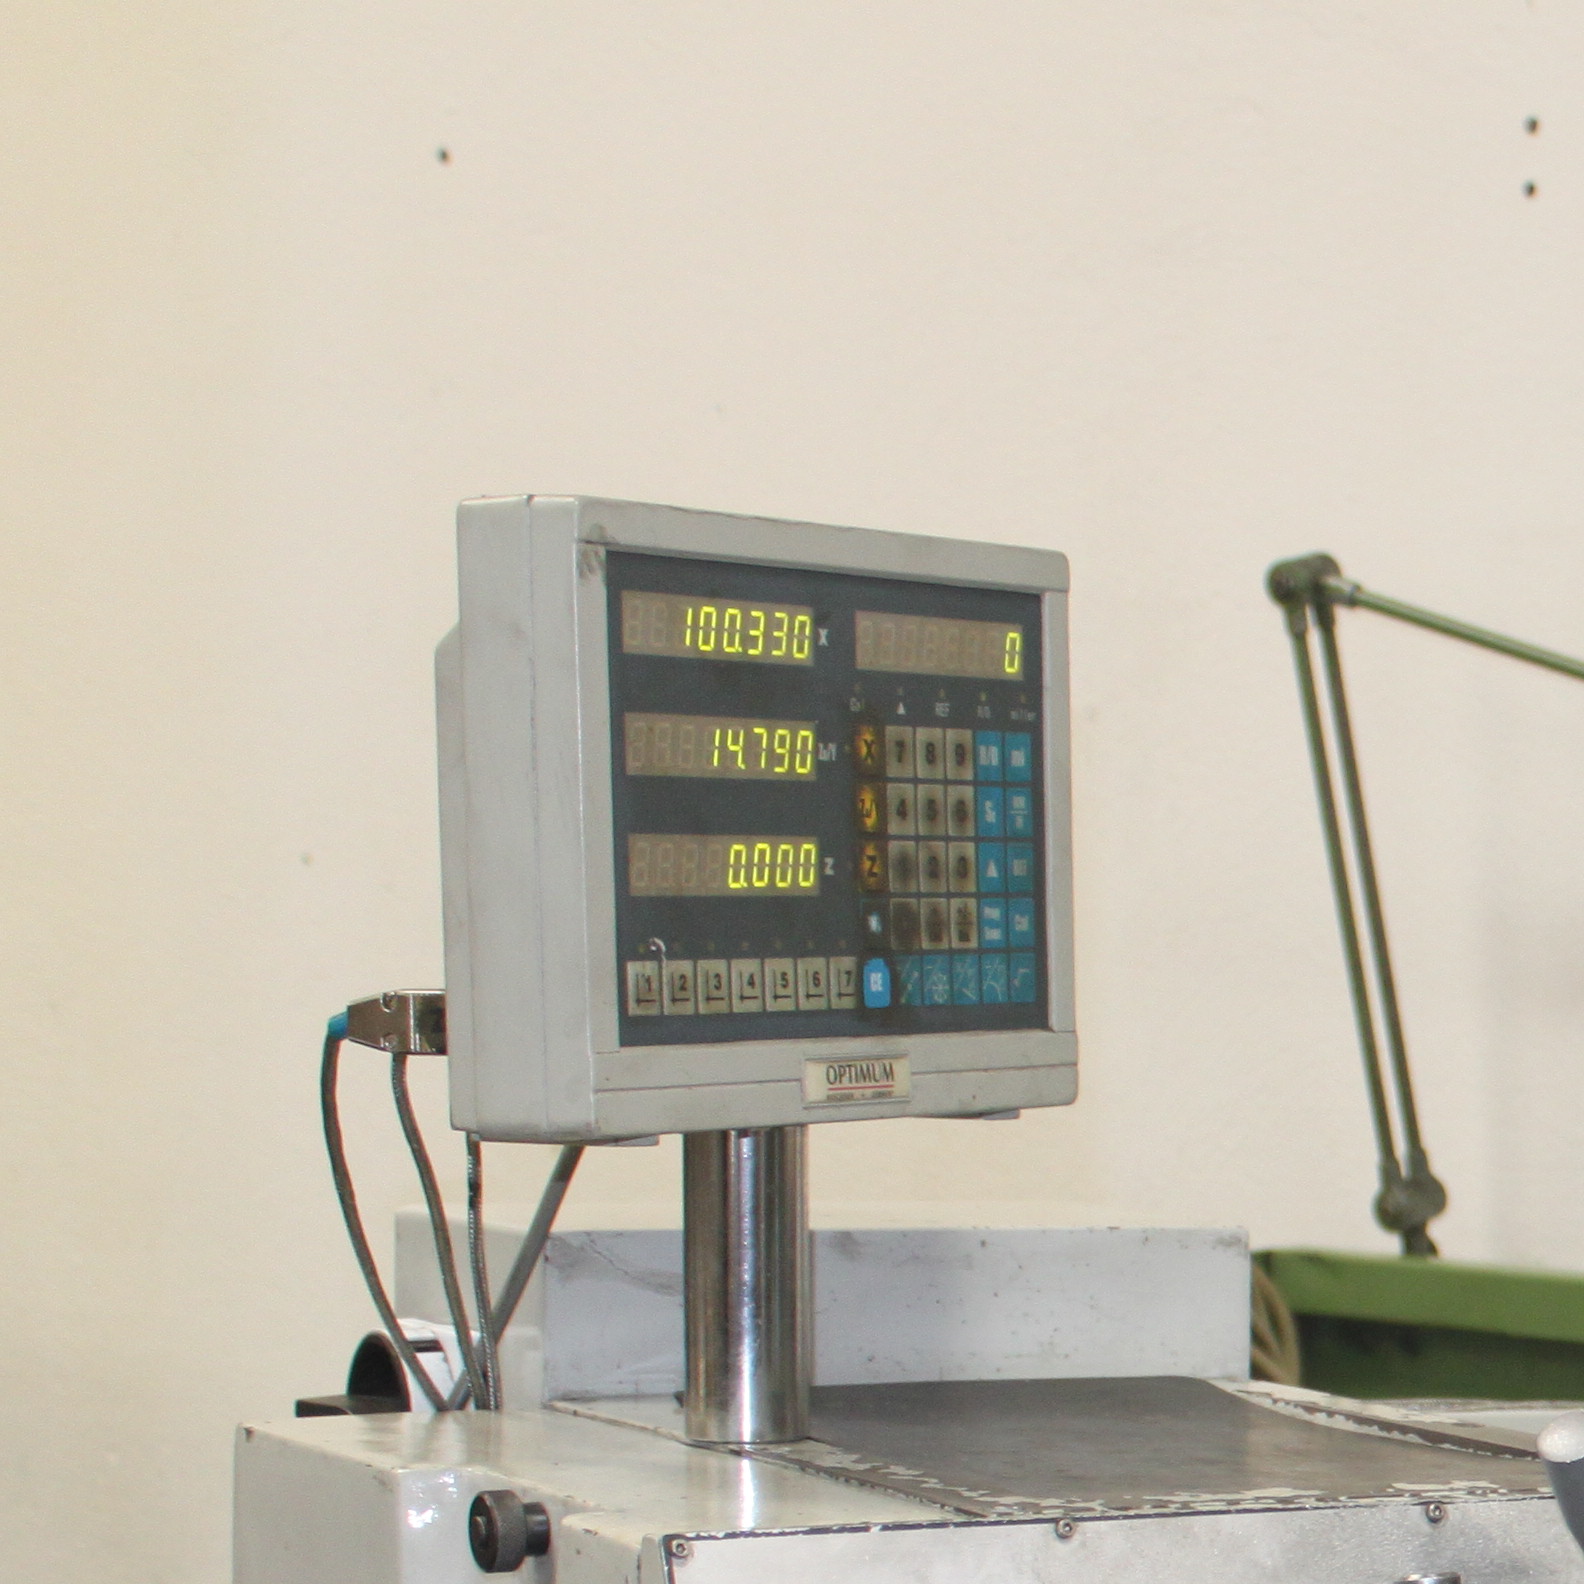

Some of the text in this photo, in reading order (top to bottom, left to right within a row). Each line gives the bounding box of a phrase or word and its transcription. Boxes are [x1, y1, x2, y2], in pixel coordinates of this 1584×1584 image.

[818, 628, 828, 646] X
[679, 974, 687, 991] 2
[714, 973, 722, 990] 3
[747, 973, 755, 989] 4
[780, 972, 788, 988] 5
[813, 971, 821, 987] 6
[844, 970, 852, 987] 7
[826, 1062, 894, 1085] OPTIMUM
